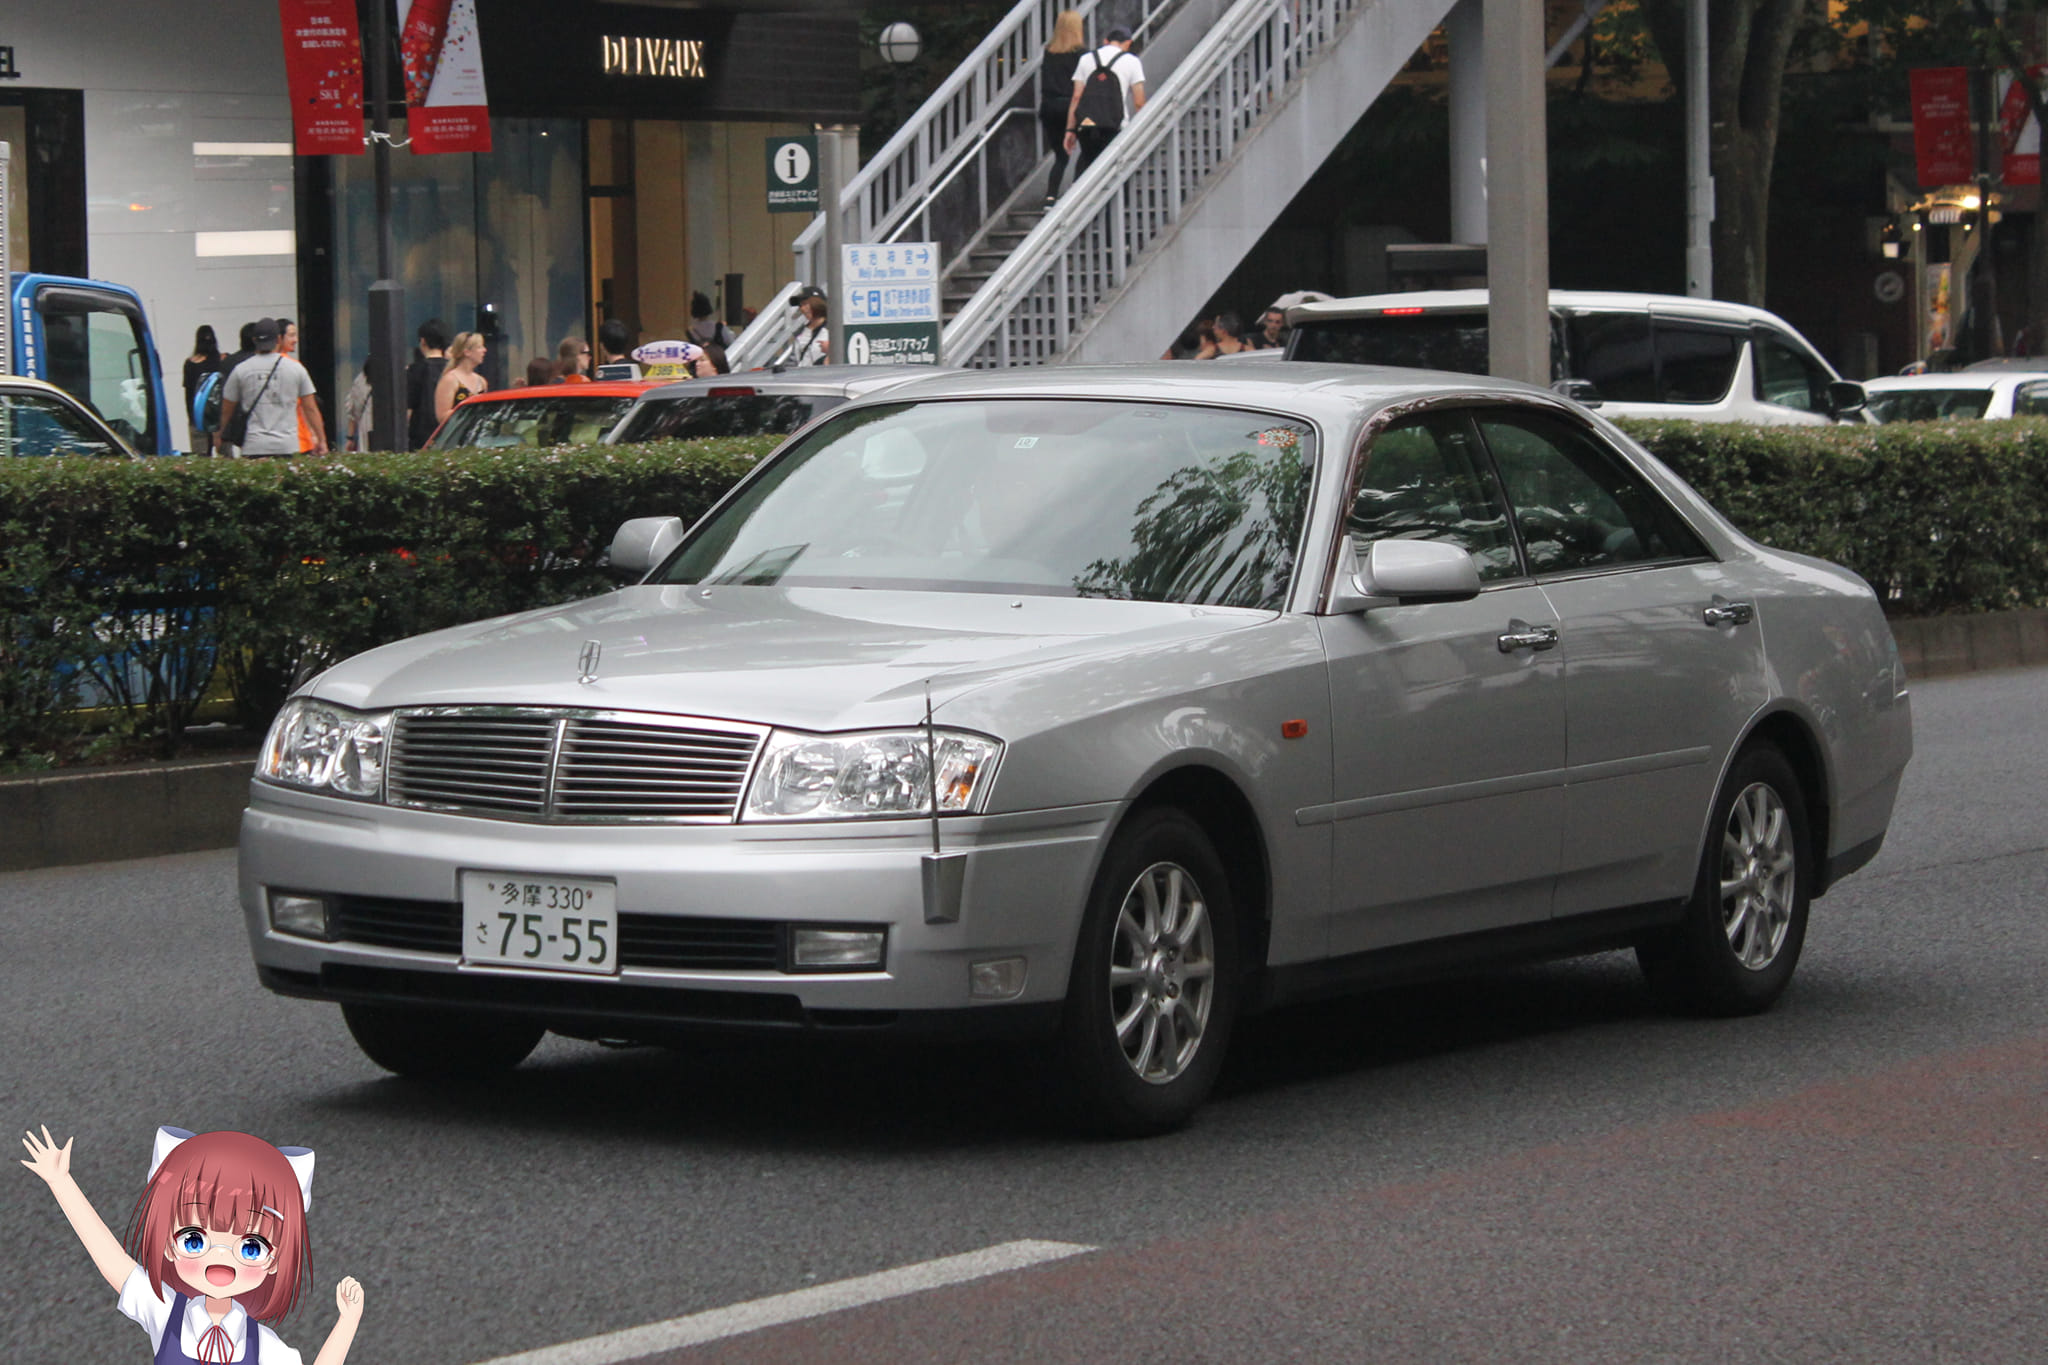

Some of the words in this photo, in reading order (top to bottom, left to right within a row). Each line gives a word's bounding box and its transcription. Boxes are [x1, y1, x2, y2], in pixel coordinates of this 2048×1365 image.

[500, 882, 542, 907] 多摩
[547, 886, 584, 911] 330
[476, 921, 488, 944] さ
[498, 912, 608, 964] 75-55
